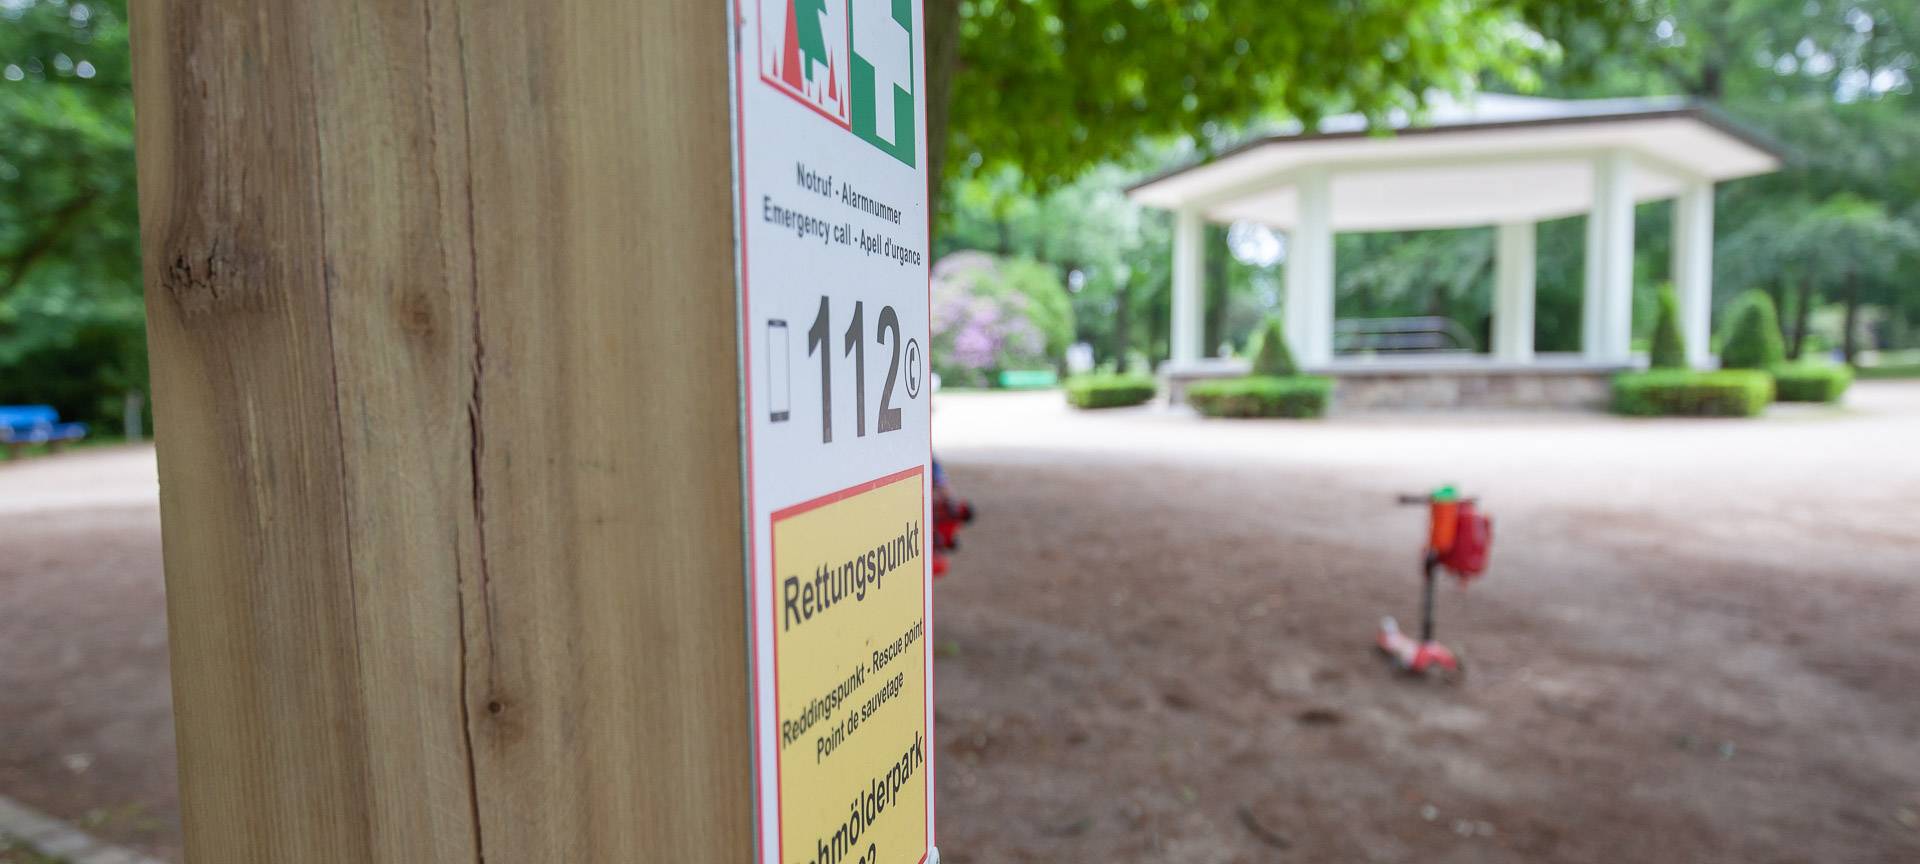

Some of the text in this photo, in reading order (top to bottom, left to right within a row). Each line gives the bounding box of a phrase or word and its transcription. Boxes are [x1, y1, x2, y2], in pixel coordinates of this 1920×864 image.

[763, 195, 830, 245] Emergency
[834, 223, 851, 246] call
[860, 229, 882, 257] Apell
[884, 238, 921, 266] d'urgance
[796, 161, 832, 198] Notruf
[841, 182, 902, 225] Alarmnummer
[808, 295, 902, 444] 112
[784, 520, 920, 632] Rettungspunkt
[782, 662, 865, 750] Reddingspunkt
[872, 637, 903, 674] Rescue
[904, 618, 923, 653] point
[817, 672, 904, 764] Point de sauvetage
